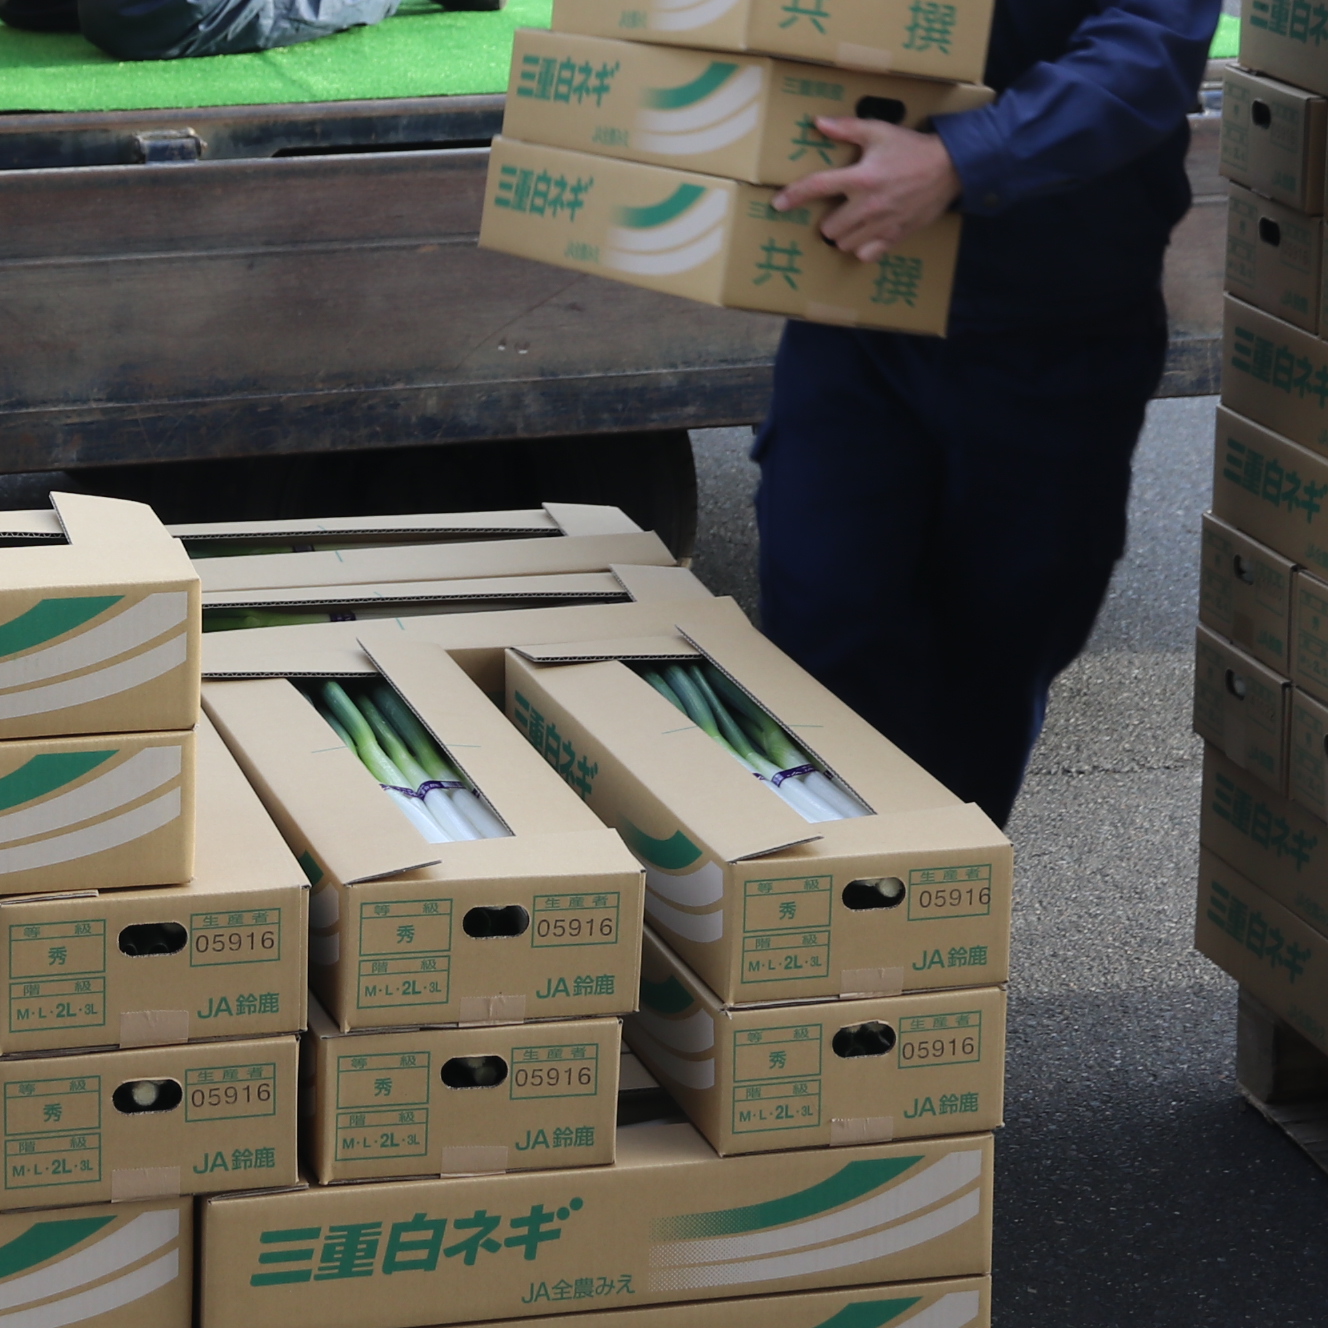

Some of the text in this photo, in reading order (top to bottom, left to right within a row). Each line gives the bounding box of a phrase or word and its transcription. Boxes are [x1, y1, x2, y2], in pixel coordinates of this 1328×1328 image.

[904, 1, 955, 53] 撰
[516, 54, 620, 108] 三重白ネギ
[494, 163, 594, 222] 三重白ネギ
[754, 240, 922, 306] 共 撰
[1224, 439, 1328, 522] 三重白ネギ
[920, 885, 990, 910] 05916
[398, 925, 414, 943] 秀
[538, 918, 612, 937] 05916
[196, 931, 274, 952] 05916
[49, 947, 66, 965] 秀
[913, 946, 988, 971] JA鈴鹿
[536, 975, 614, 999] JA鈴鹿
[198, 993, 279, 1019] JA鈴鹿
[903, 1037, 974, 1060] 05916
[515, 1067, 590, 1087] 05916
[189, 1083, 270, 1107] 05916
[904, 1093, 978, 1119] JA鈴鹿
[516, 1127, 594, 1151] JA鈴鹿
[194, 1147, 275, 1174] JA鈴鹿
[251, 1198, 585, 1289] 三重白ネギ
[522, 1274, 635, 1303] JA全農みえ
